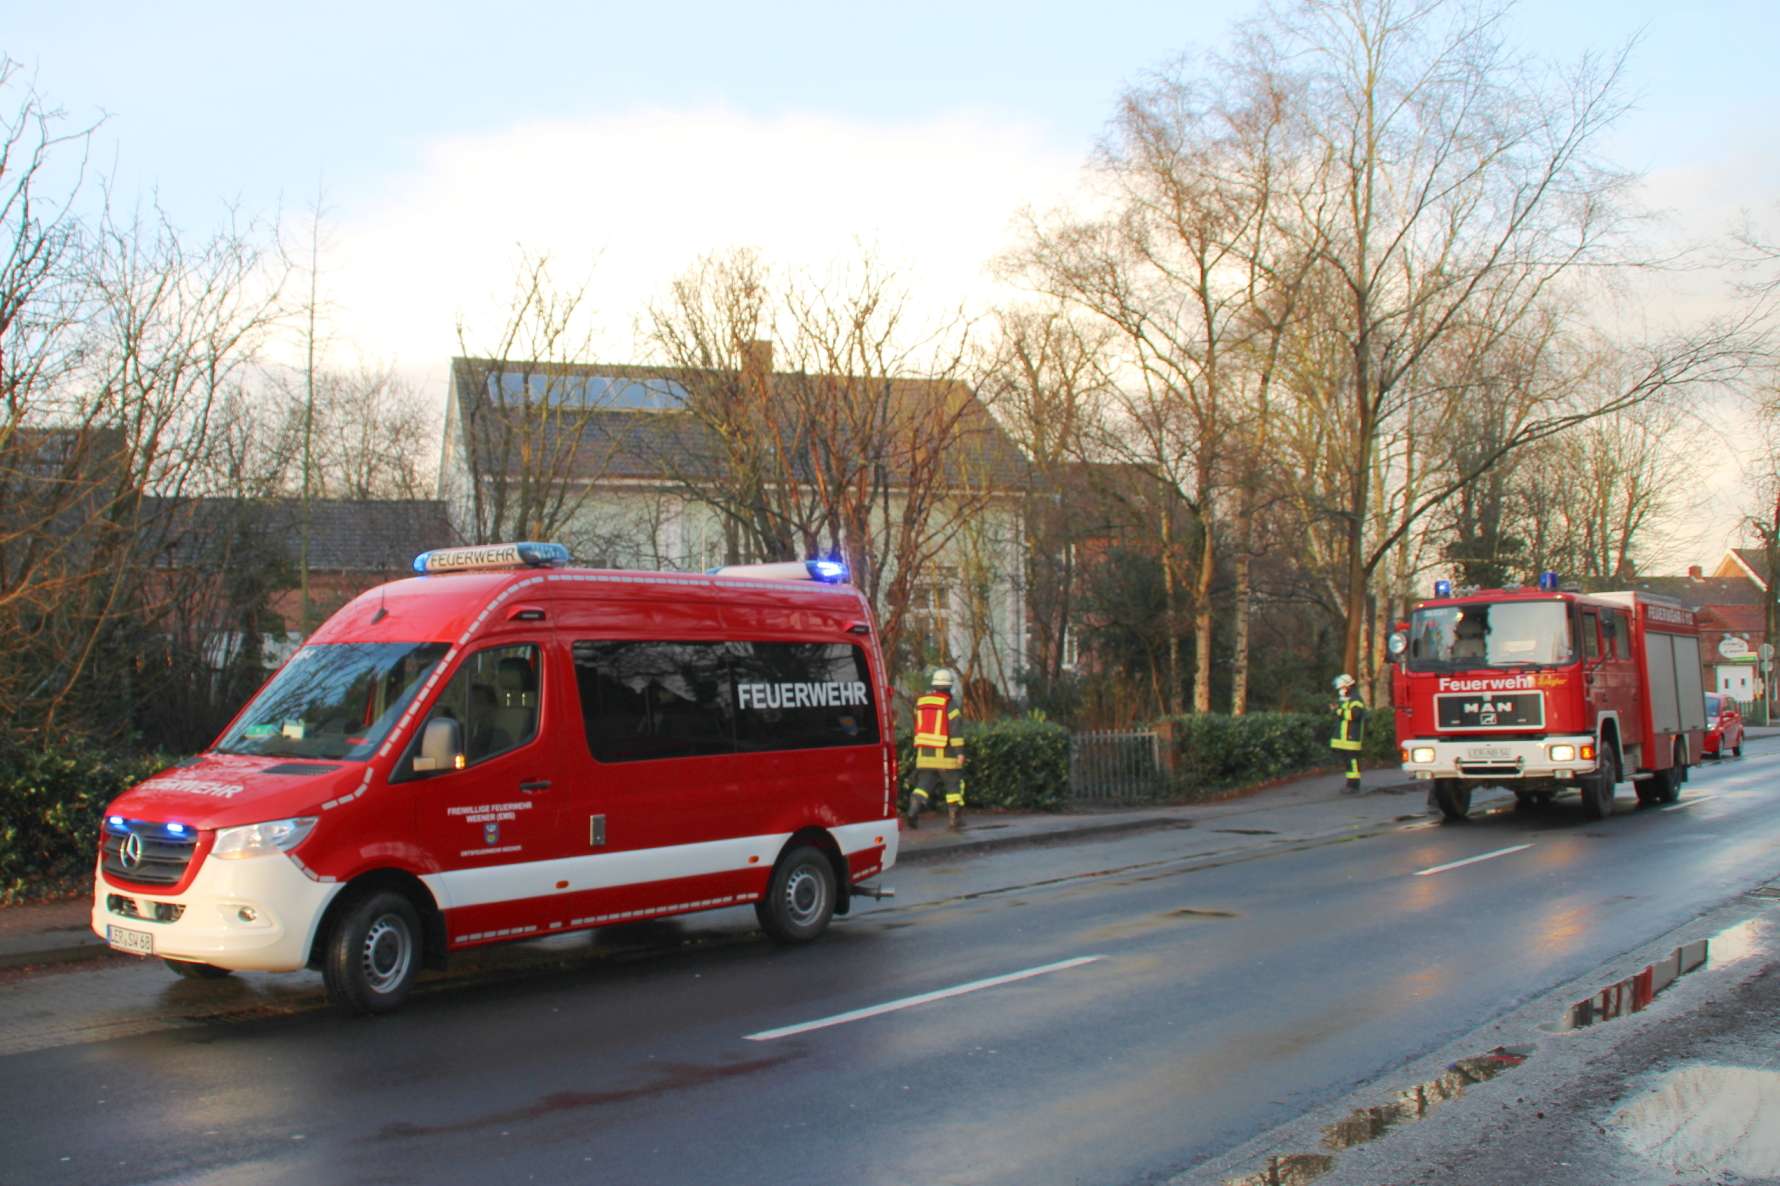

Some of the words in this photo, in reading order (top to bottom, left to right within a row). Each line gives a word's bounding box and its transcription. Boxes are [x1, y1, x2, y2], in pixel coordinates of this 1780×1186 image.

[431, 549, 514, 567] FEUERWEHR
[737, 681, 868, 709] FEUERWEHR
[1463, 702, 1513, 713] MAN
[447, 805, 490, 816] FREIWILLIGE
[491, 801, 533, 812] FEUERWEHR
